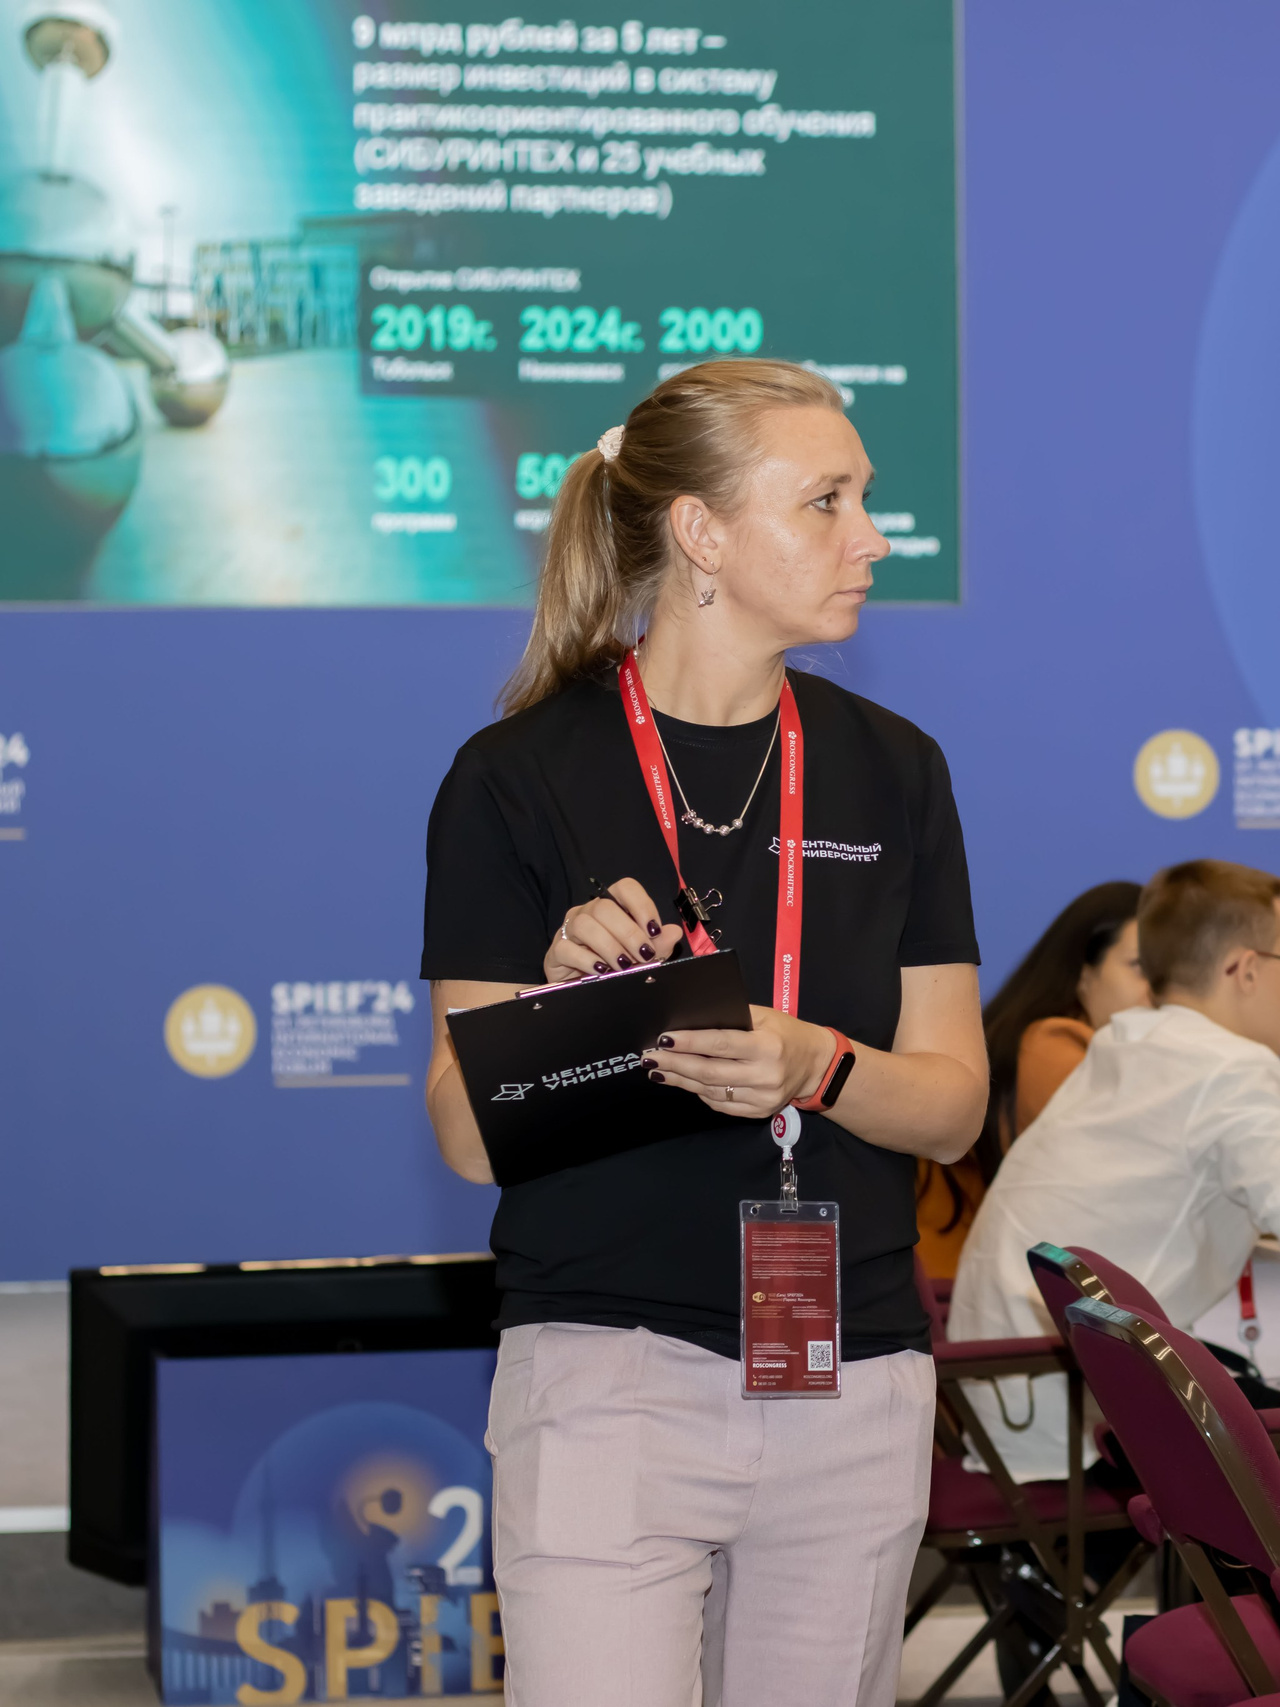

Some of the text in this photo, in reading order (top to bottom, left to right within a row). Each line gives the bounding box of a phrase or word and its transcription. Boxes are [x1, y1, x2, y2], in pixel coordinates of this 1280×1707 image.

[353, 15, 375, 48] 9
[466, 18, 578, 57] рублей
[645, 27, 702, 55] лет
[354, 61, 462, 96] размер
[463, 60, 631, 99] инвестиций
[657, 67, 778, 102] систему
[742, 103, 876, 142] обучения
[601, 140, 641, 174] 25
[354, 178, 507, 216] заведений
[658, 306, 764, 353] 2000
[373, 456, 452, 501] 300
[650, 764, 670, 820] РОСКОНГРЕСС
[802, 840, 882, 852] ЕНТРАЛЬНЫЙ
[803, 850, 879, 861] НИВЕРСИТЕТ
[786, 849, 795, 906] РОСКОНГРЕСС
[544, 1060, 642, 1090] УНИВЕР
[236, 1591, 505, 1705] SPIE
